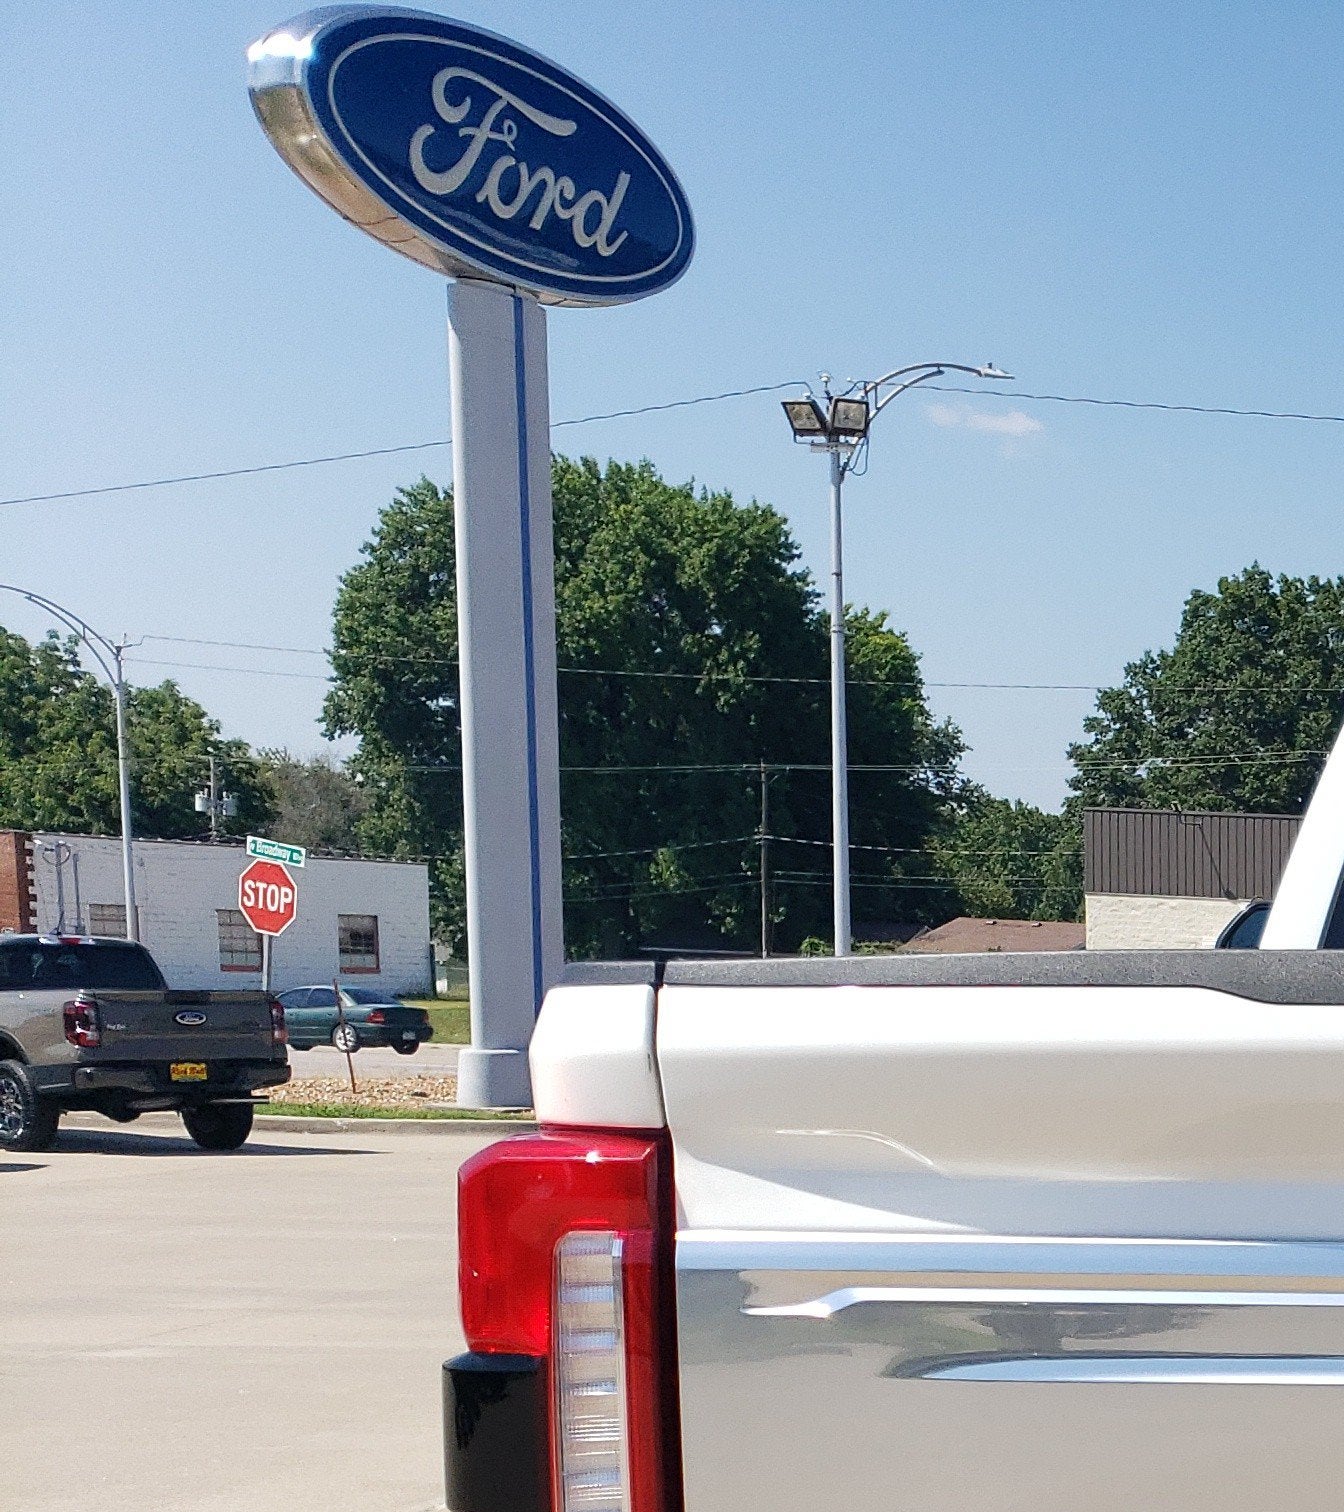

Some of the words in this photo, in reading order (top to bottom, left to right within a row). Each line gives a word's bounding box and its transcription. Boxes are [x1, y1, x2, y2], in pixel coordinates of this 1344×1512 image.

[409, 66, 631, 257] Ford
[256, 840, 292, 862] Broadway
[243, 879, 293, 914] STOP
